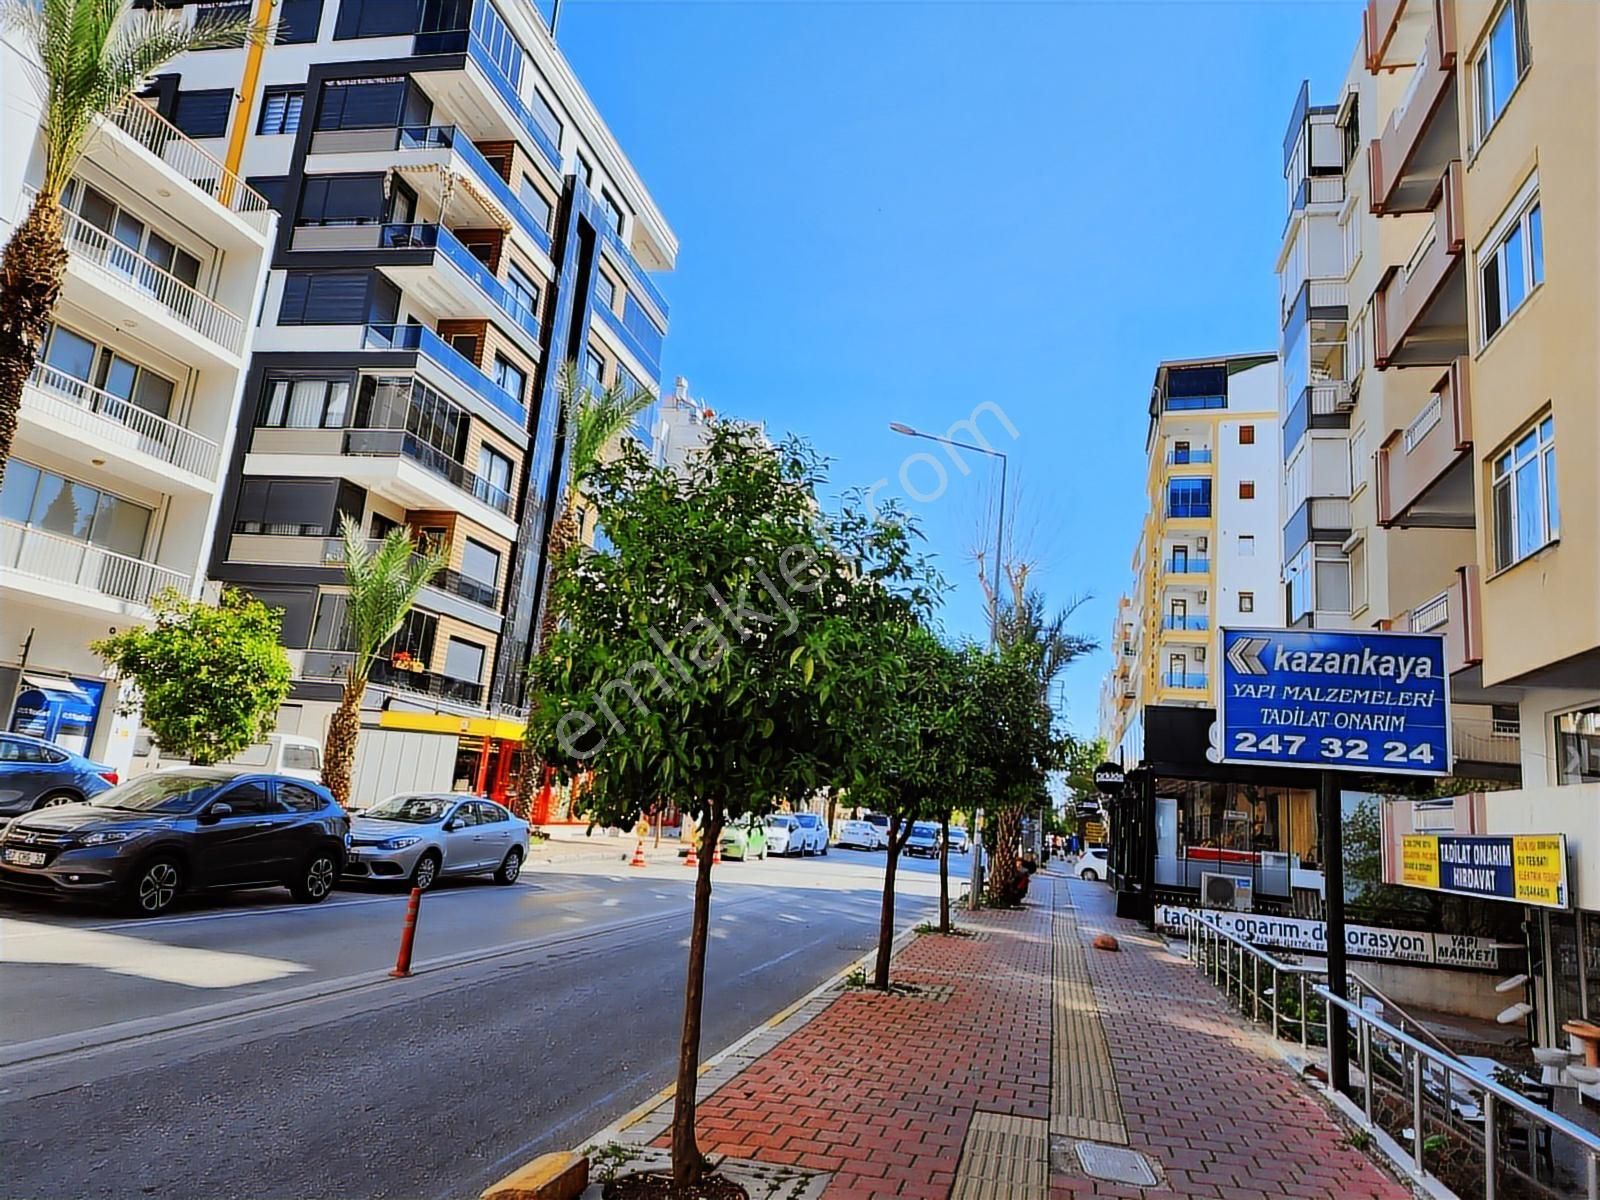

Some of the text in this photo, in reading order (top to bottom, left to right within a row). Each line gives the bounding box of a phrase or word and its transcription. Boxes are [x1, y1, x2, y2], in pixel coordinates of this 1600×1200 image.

[1274, 644, 1432, 684] kazankaya
[1233, 684, 1435, 707] YAPI MALZEMELERİ
[1260, 707, 1406, 732] TADİLAT ONARIM
[1234, 732, 1434, 764] 247 32 24
[1440, 840, 1471, 865] TADİLAT
[1453, 867, 1495, 891] HIRDAVAT
[1235, 919, 1300, 939] onarım
[1312, 922, 1425, 953] dorasyon
[1451, 936, 1478, 949] YAPI
